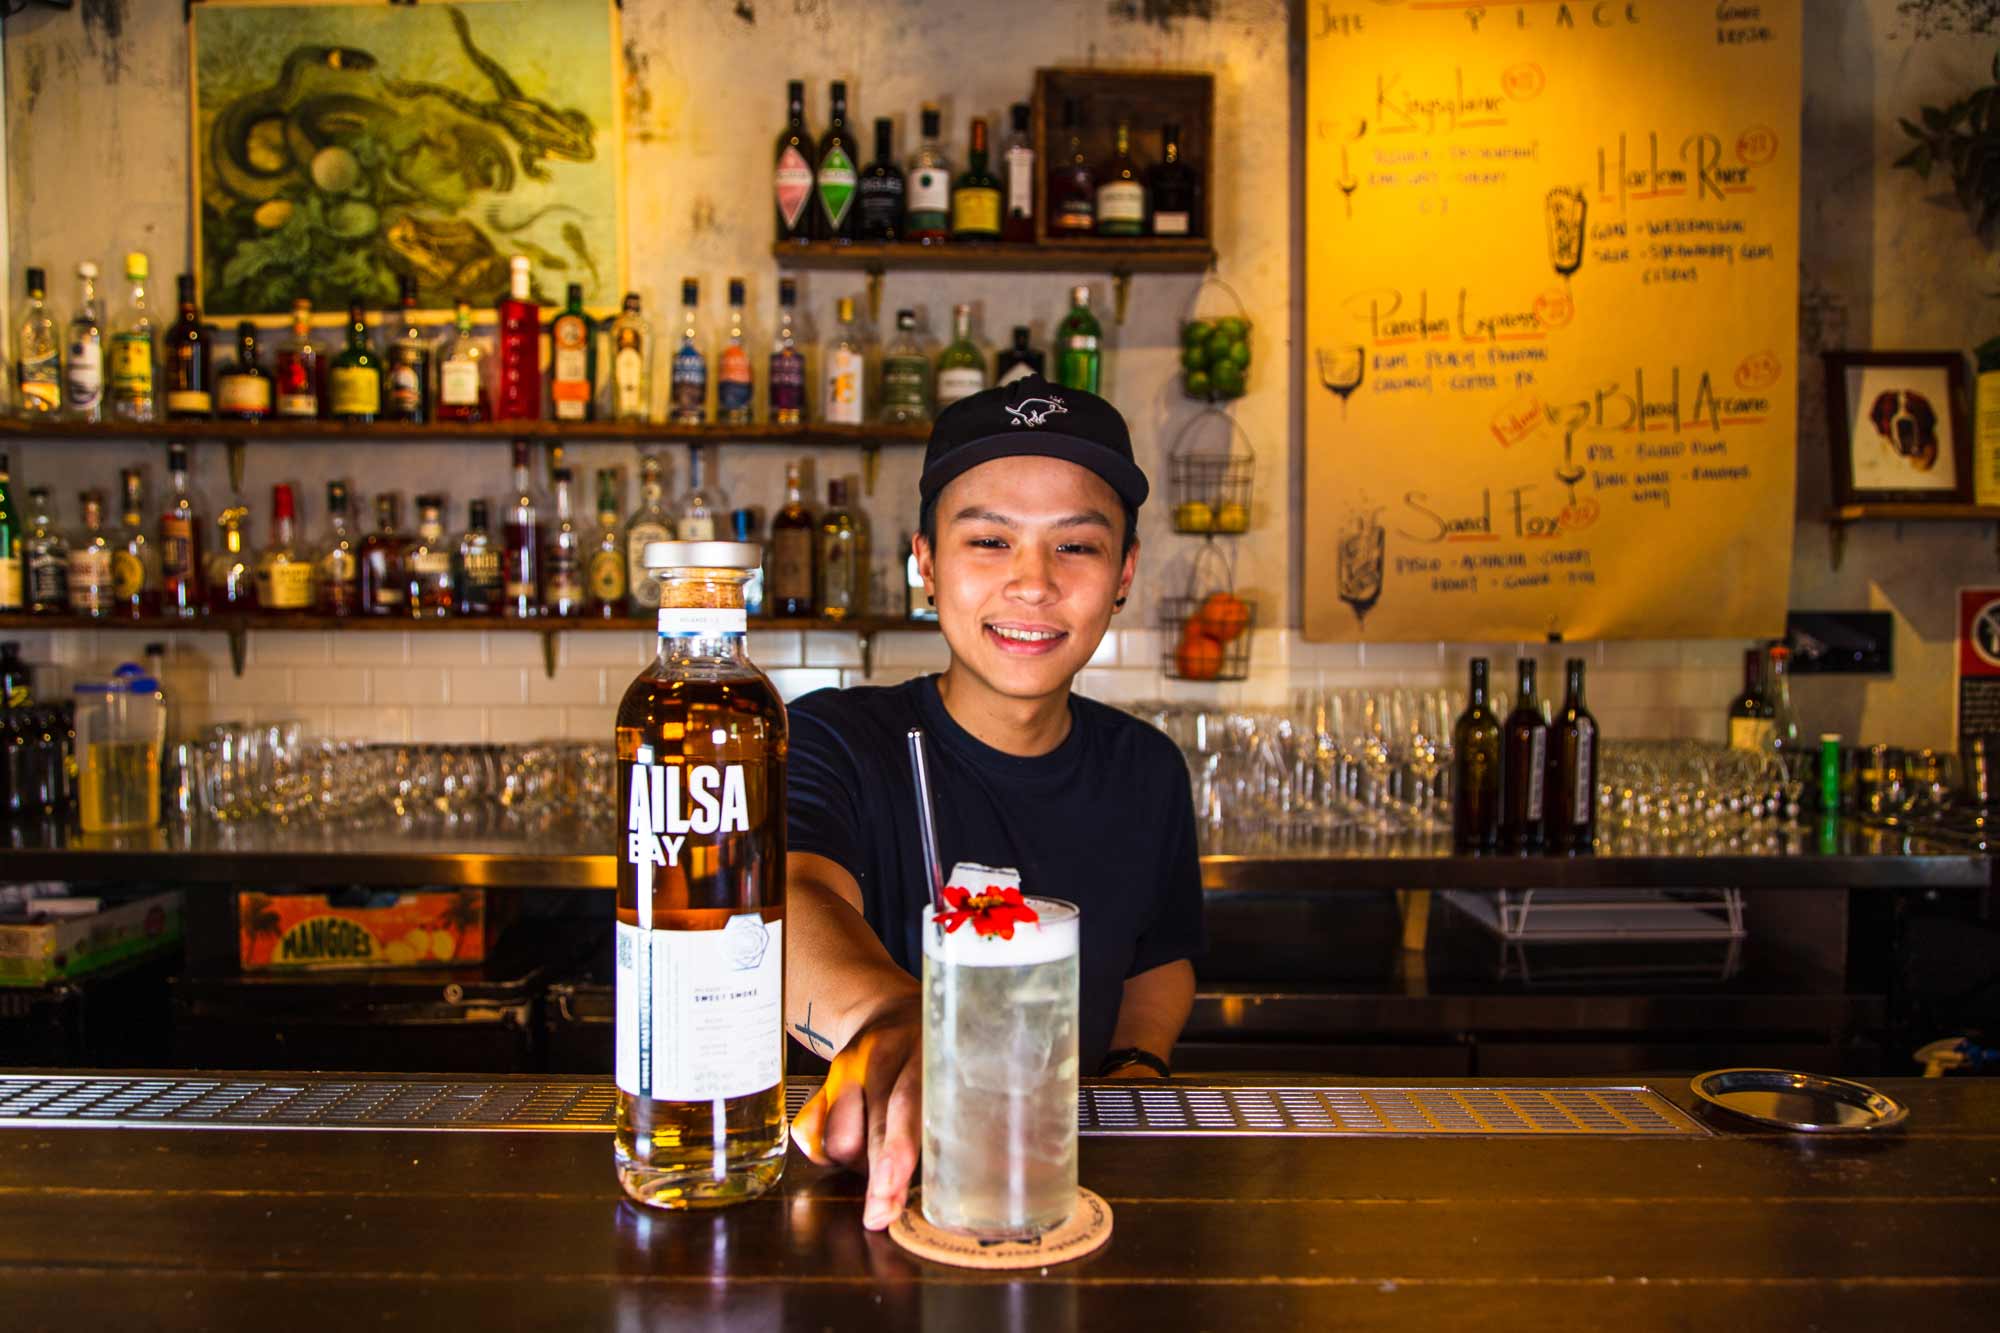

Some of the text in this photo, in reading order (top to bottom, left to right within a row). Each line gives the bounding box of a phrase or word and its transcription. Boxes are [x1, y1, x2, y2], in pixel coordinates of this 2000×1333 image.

[628, 763, 750, 834] AILSA
[628, 832, 686, 867] BAY
[282, 916, 374, 960] MANGOES
